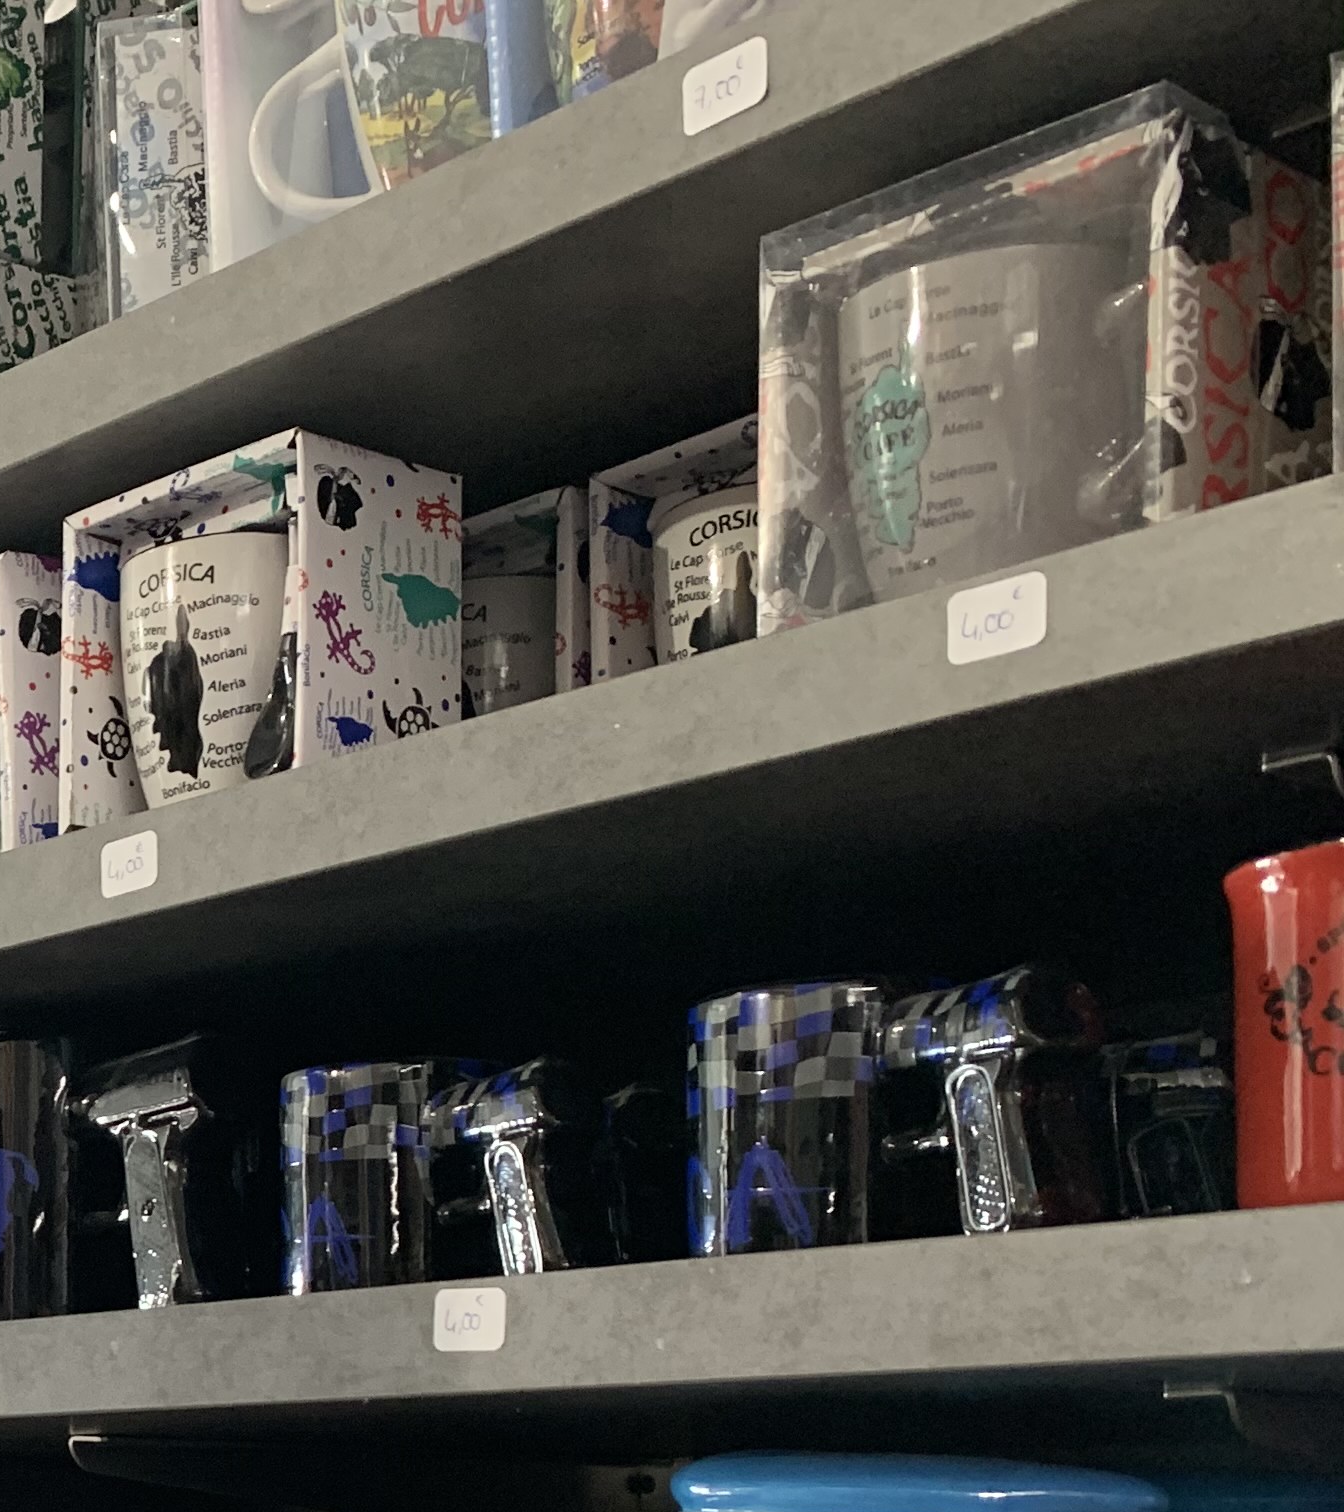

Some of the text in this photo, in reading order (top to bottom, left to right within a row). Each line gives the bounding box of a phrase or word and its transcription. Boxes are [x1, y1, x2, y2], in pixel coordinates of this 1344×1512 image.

[167, 130, 178, 165] Bastia
[670, 554, 703, 571] Le Cap
[361, 545, 374, 612] CORSICA
[187, 593, 259, 614] Macinaggio
[668, 612, 689, 628] Calvi
[192, 625, 231, 640] Bastia
[200, 644, 248, 667] Moriani
[207, 677, 246, 692] Aleria
[203, 702, 263, 726] Solenzara
[202, 751, 245, 768] Vecchi
[162, 778, 210, 800] Bonifacio
